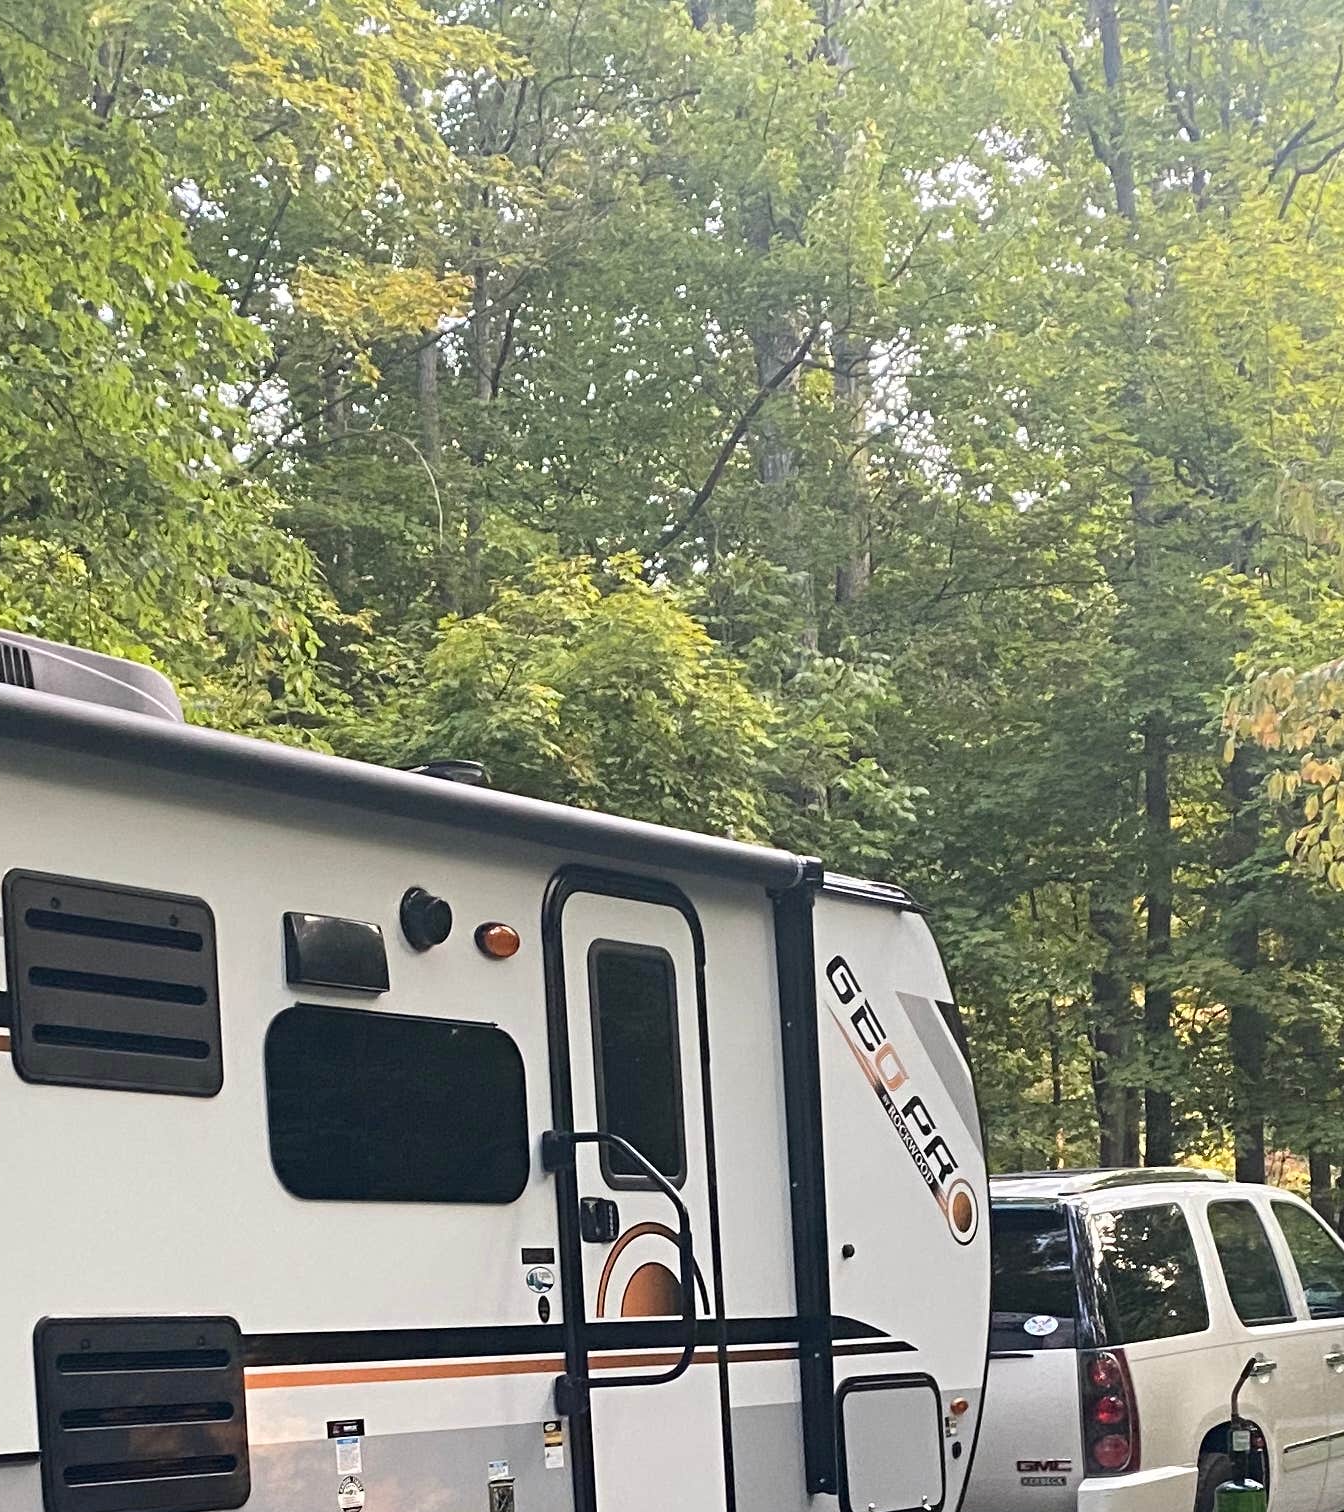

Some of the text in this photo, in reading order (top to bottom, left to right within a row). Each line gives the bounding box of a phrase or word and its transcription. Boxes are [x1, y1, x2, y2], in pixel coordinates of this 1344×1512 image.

[825, 955, 910, 1092] GEO
[888, 1103, 934, 1184] ROCKWOOD
[1017, 1459, 1073, 1472] GMC
